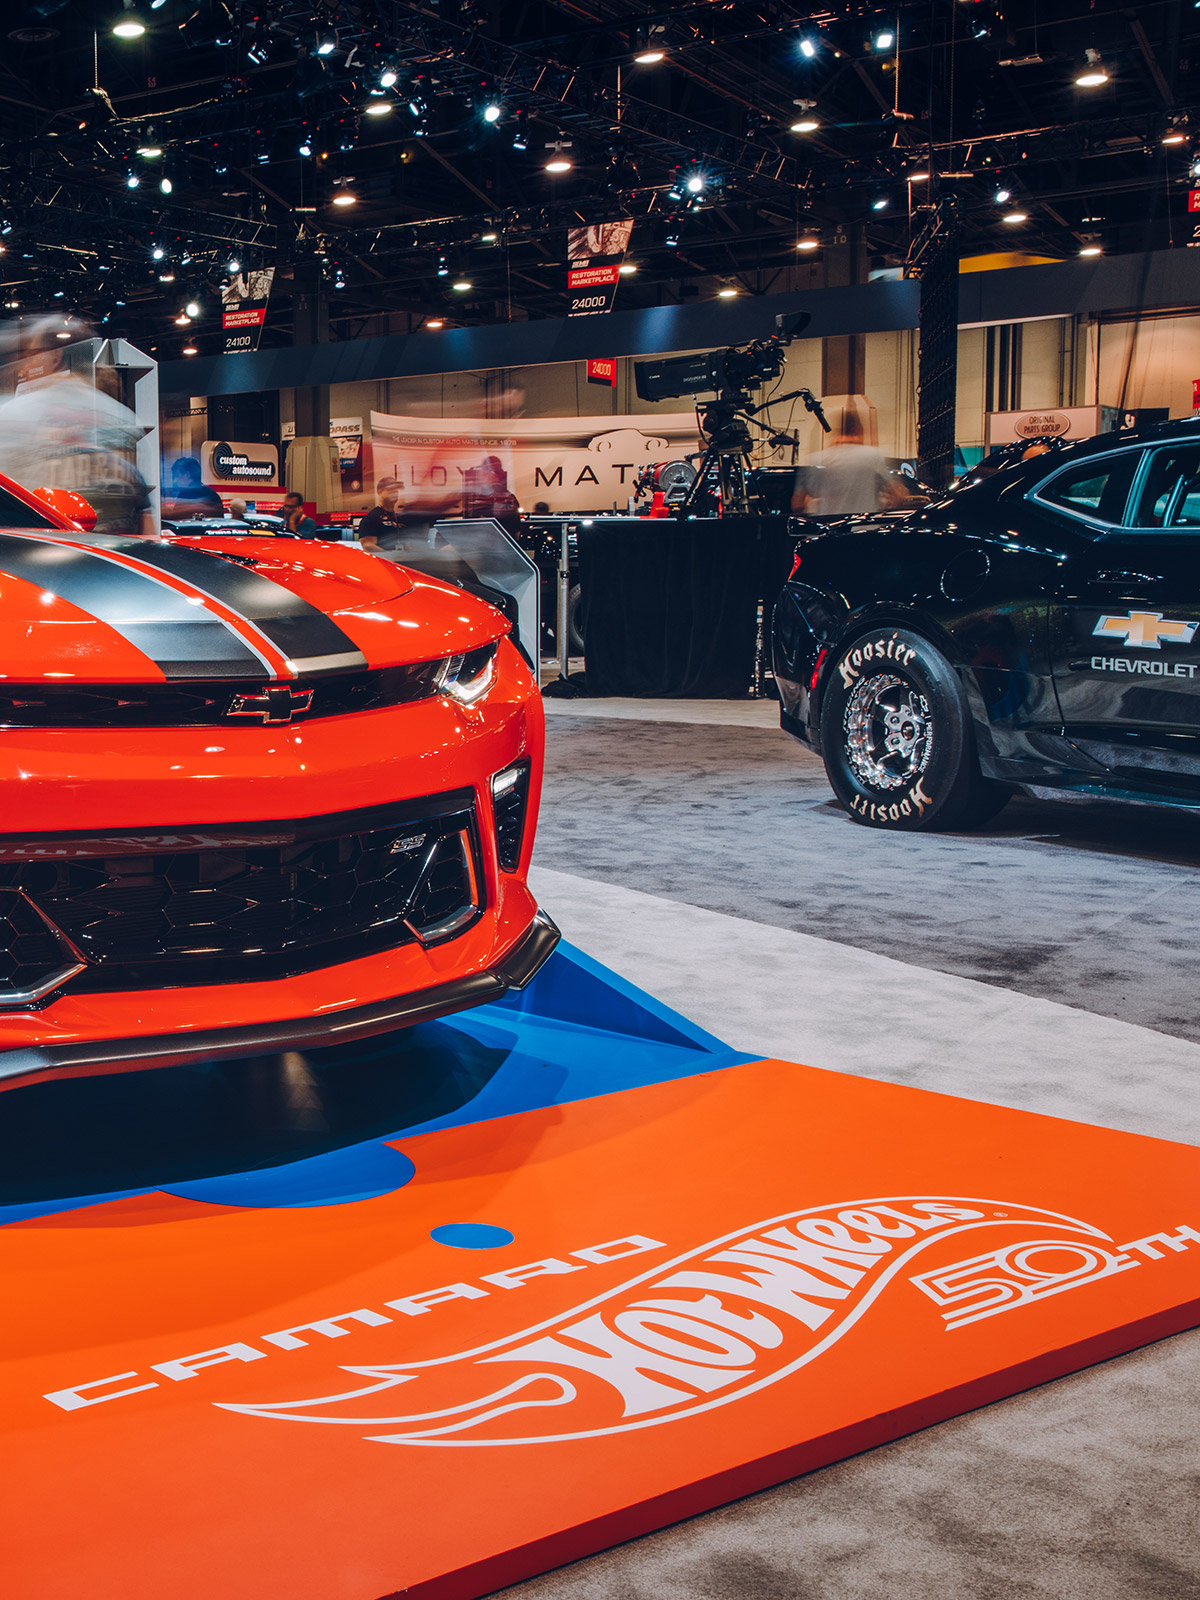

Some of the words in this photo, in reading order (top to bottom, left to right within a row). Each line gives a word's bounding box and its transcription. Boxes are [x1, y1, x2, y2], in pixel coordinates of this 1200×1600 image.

[571, 268, 612, 279] RESTORATION
[571, 275, 614, 286] MARKETPLACE
[571, 296, 606, 309] 24000
[225, 312, 258, 321] RESTORATION
[225, 317, 260, 327] MARKETPLACE
[225, 336, 251, 348] 24100
[592, 361, 612, 376] 24000
[1029, 415, 1056, 425] ORIGINAL
[1024, 425, 1040, 434] PARTS
[1042, 424, 1061, 433] GROUP
[219, 455, 248, 466] custom
[231, 464, 272, 476] autosound
[534, 463, 635, 488] MAT
[838, 632, 917, 690] Hoosier
[1090, 656, 1198, 679] CHEVROLET
[919, 721, 934, 775] PERFORMANCE
[42, 1234, 668, 1412] CAMARO
